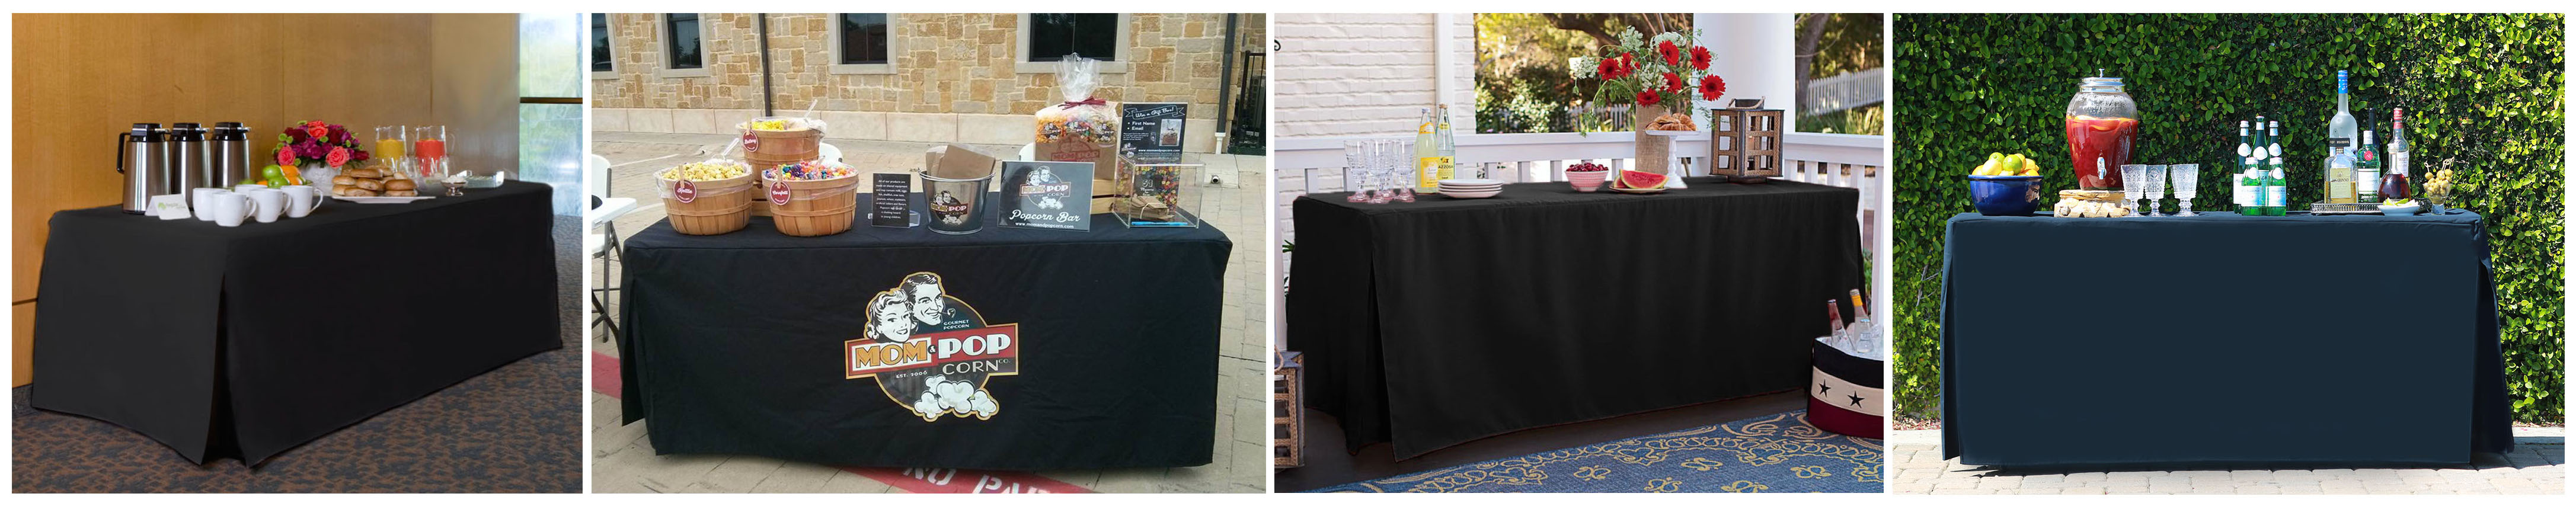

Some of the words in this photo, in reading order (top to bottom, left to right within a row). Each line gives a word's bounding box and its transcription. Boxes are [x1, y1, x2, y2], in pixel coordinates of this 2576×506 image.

[1009, 209, 1054, 221] Popcorn
[1056, 212, 1081, 222] Bar
[856, 340, 927, 368] MOM
[938, 334, 1011, 359] POP
[942, 360, 998, 374] CORN
